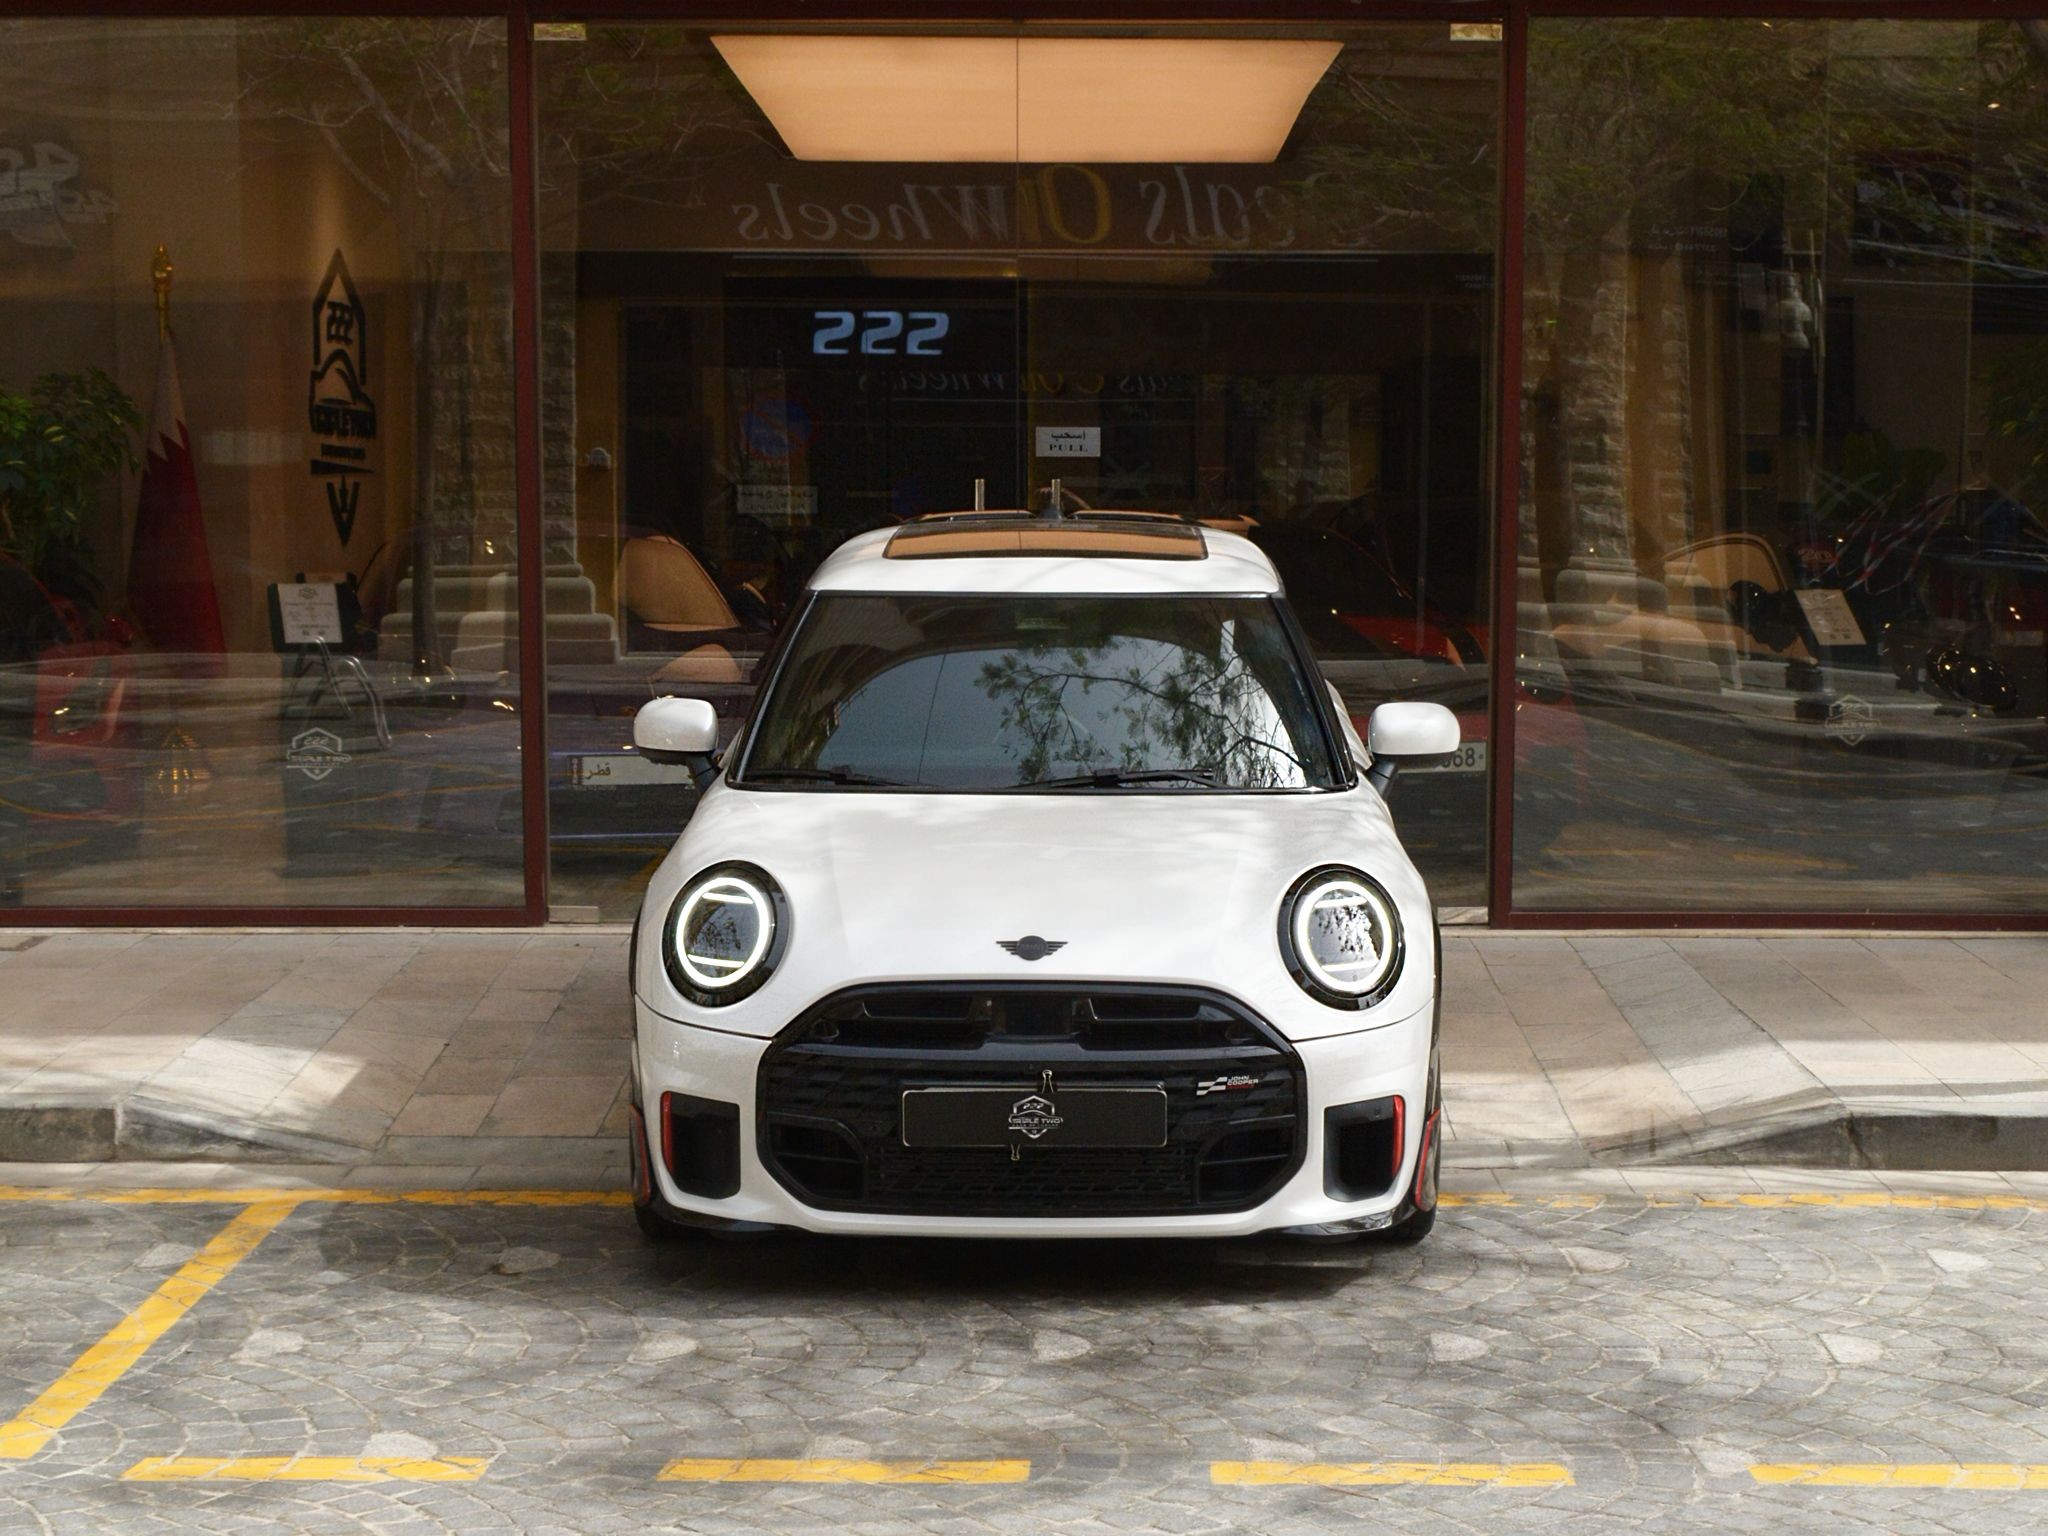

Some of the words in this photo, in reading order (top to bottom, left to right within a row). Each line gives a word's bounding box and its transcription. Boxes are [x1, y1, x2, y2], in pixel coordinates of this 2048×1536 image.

[812, 310, 950, 355] 222
[1049, 443, 1089, 453] PULL
[584, 762, 611, 779] قطر
[1227, 1078, 1259, 1086] COOPER
